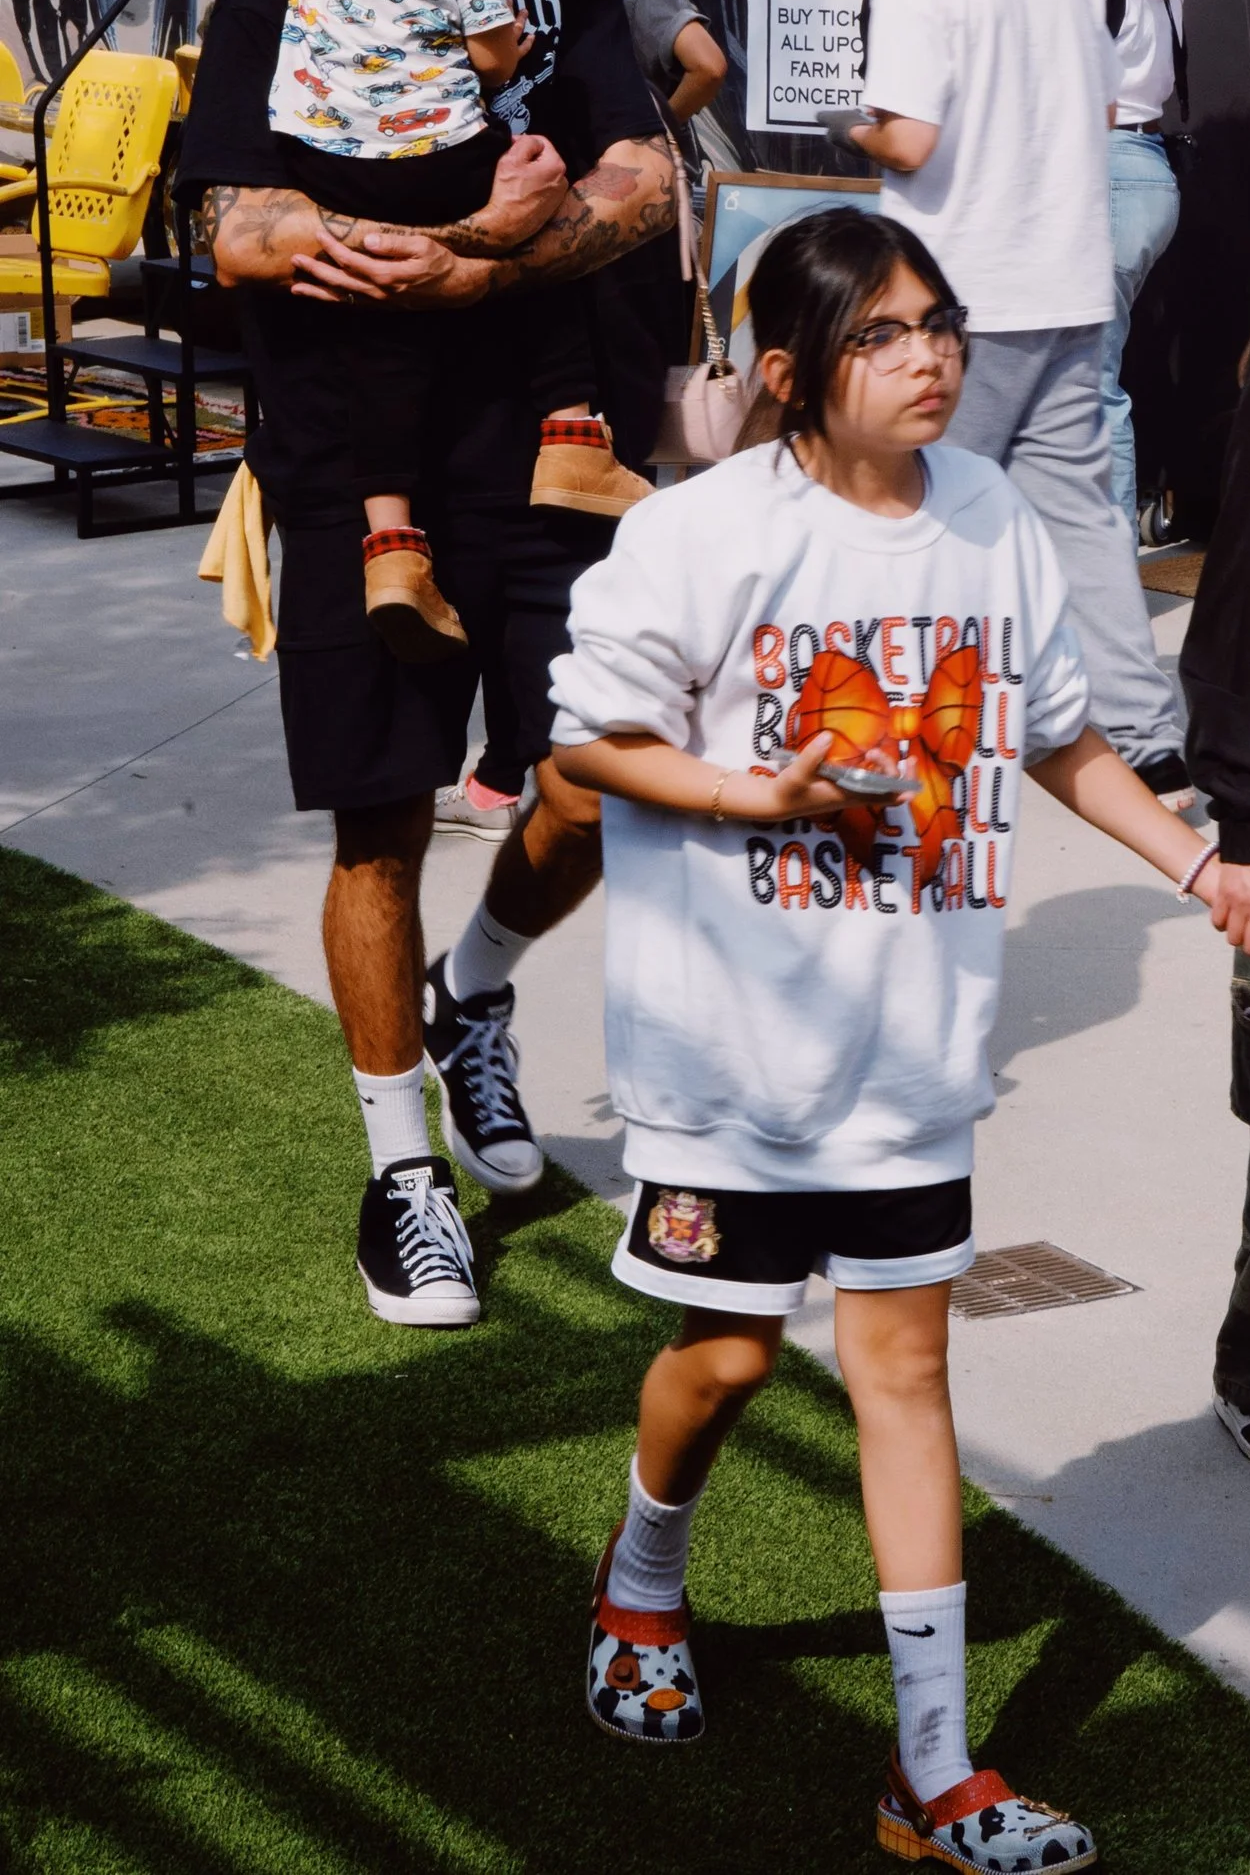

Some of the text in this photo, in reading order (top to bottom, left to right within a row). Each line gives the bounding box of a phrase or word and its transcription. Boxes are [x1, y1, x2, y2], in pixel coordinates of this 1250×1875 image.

[778, 7, 861, 26] BUY TICK
[781, 34, 814, 51] ALL
[791, 61, 840, 78] FARM
[747, 836, 1007, 914] BASKETBALL
